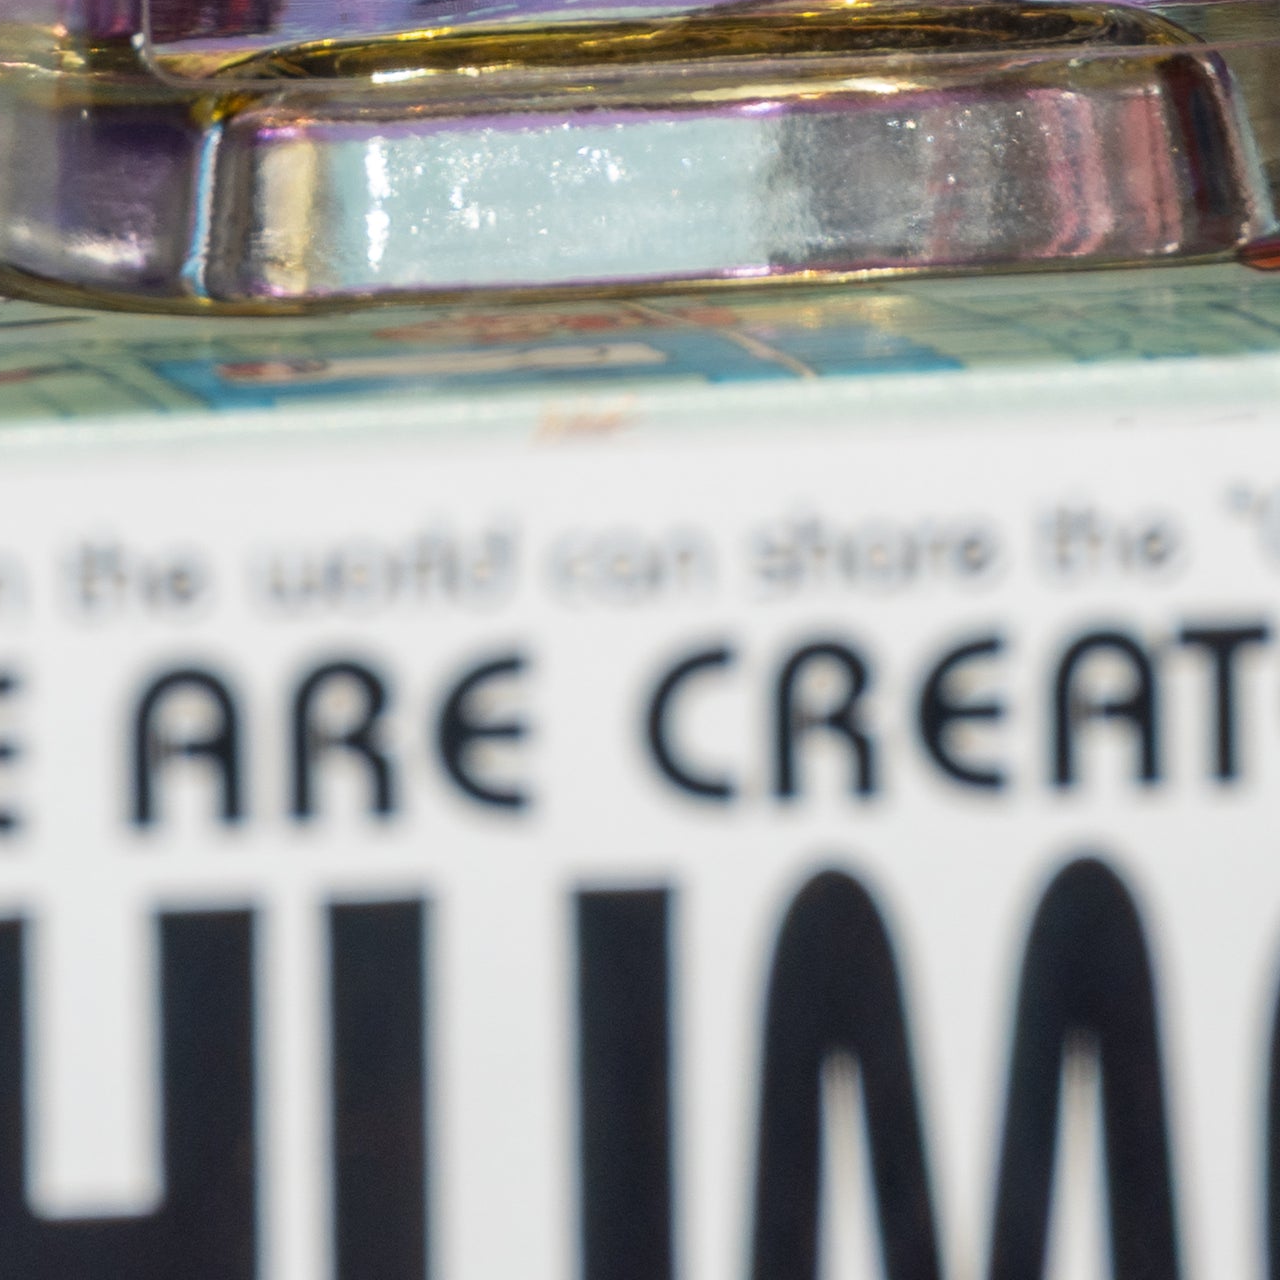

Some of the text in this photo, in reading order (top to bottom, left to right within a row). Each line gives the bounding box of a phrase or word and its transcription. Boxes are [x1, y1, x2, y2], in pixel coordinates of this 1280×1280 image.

[60, 533, 212, 610] the
[252, 524, 515, 604] world
[1041, 503, 1183, 572] the
[131, 652, 537, 830] ARE
